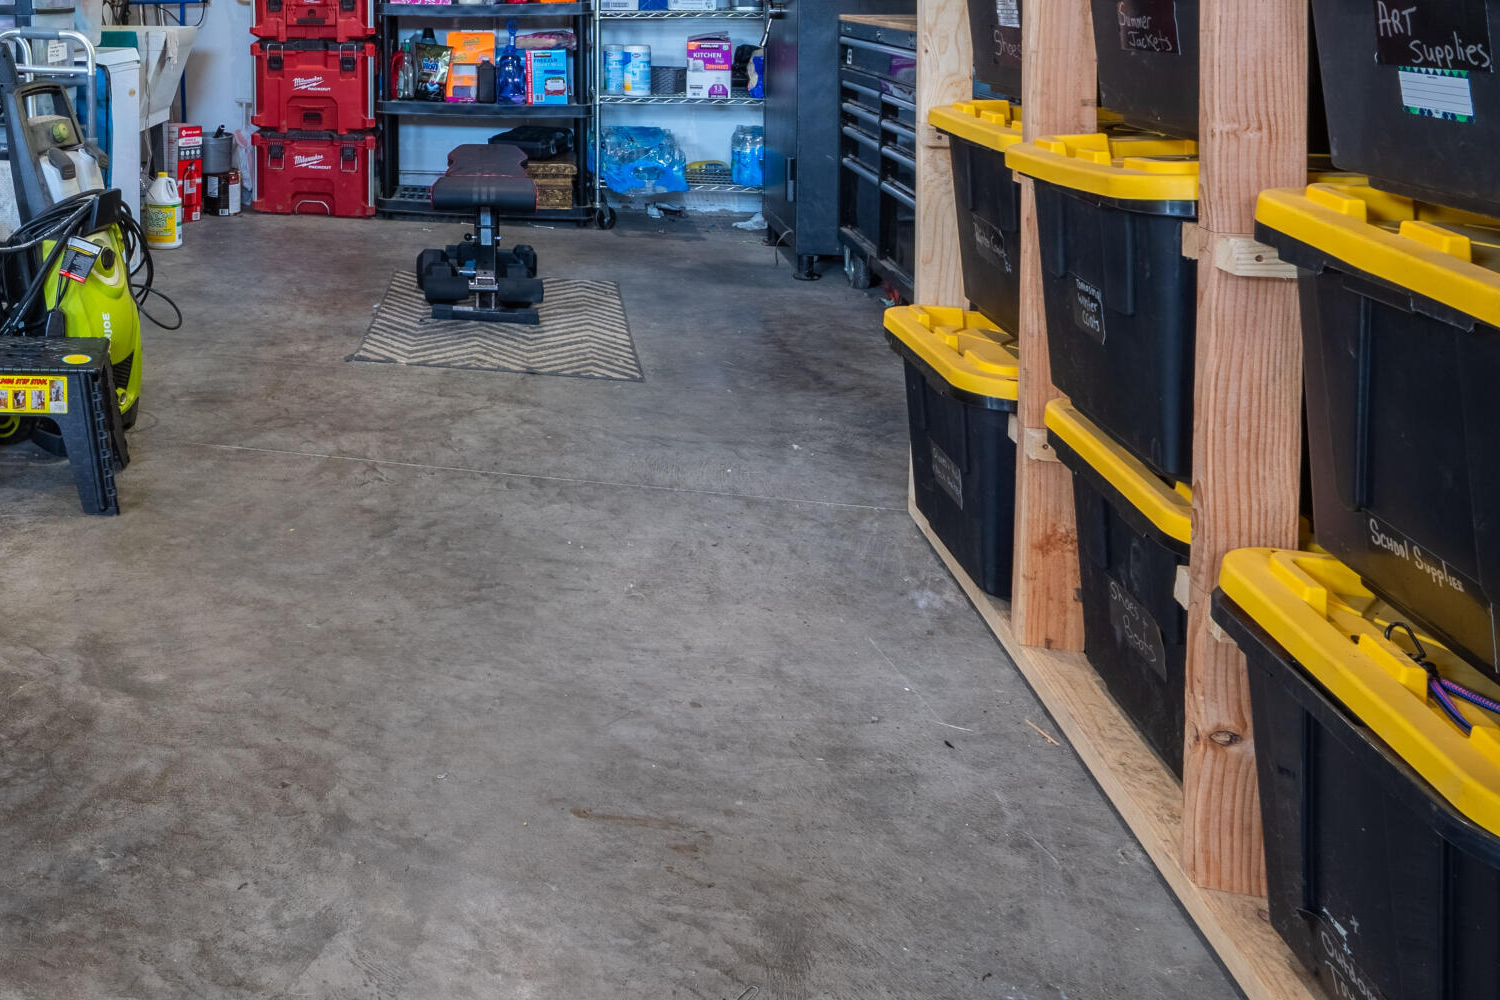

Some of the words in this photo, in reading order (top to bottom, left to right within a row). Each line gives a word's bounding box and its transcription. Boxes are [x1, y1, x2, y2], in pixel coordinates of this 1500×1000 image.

[1118, 1, 1151, 29] Summer
[1377, 0, 1417, 37] ART
[693, 51, 722, 59] KITCHEN
[1409, 31, 1490, 68] Supplies
